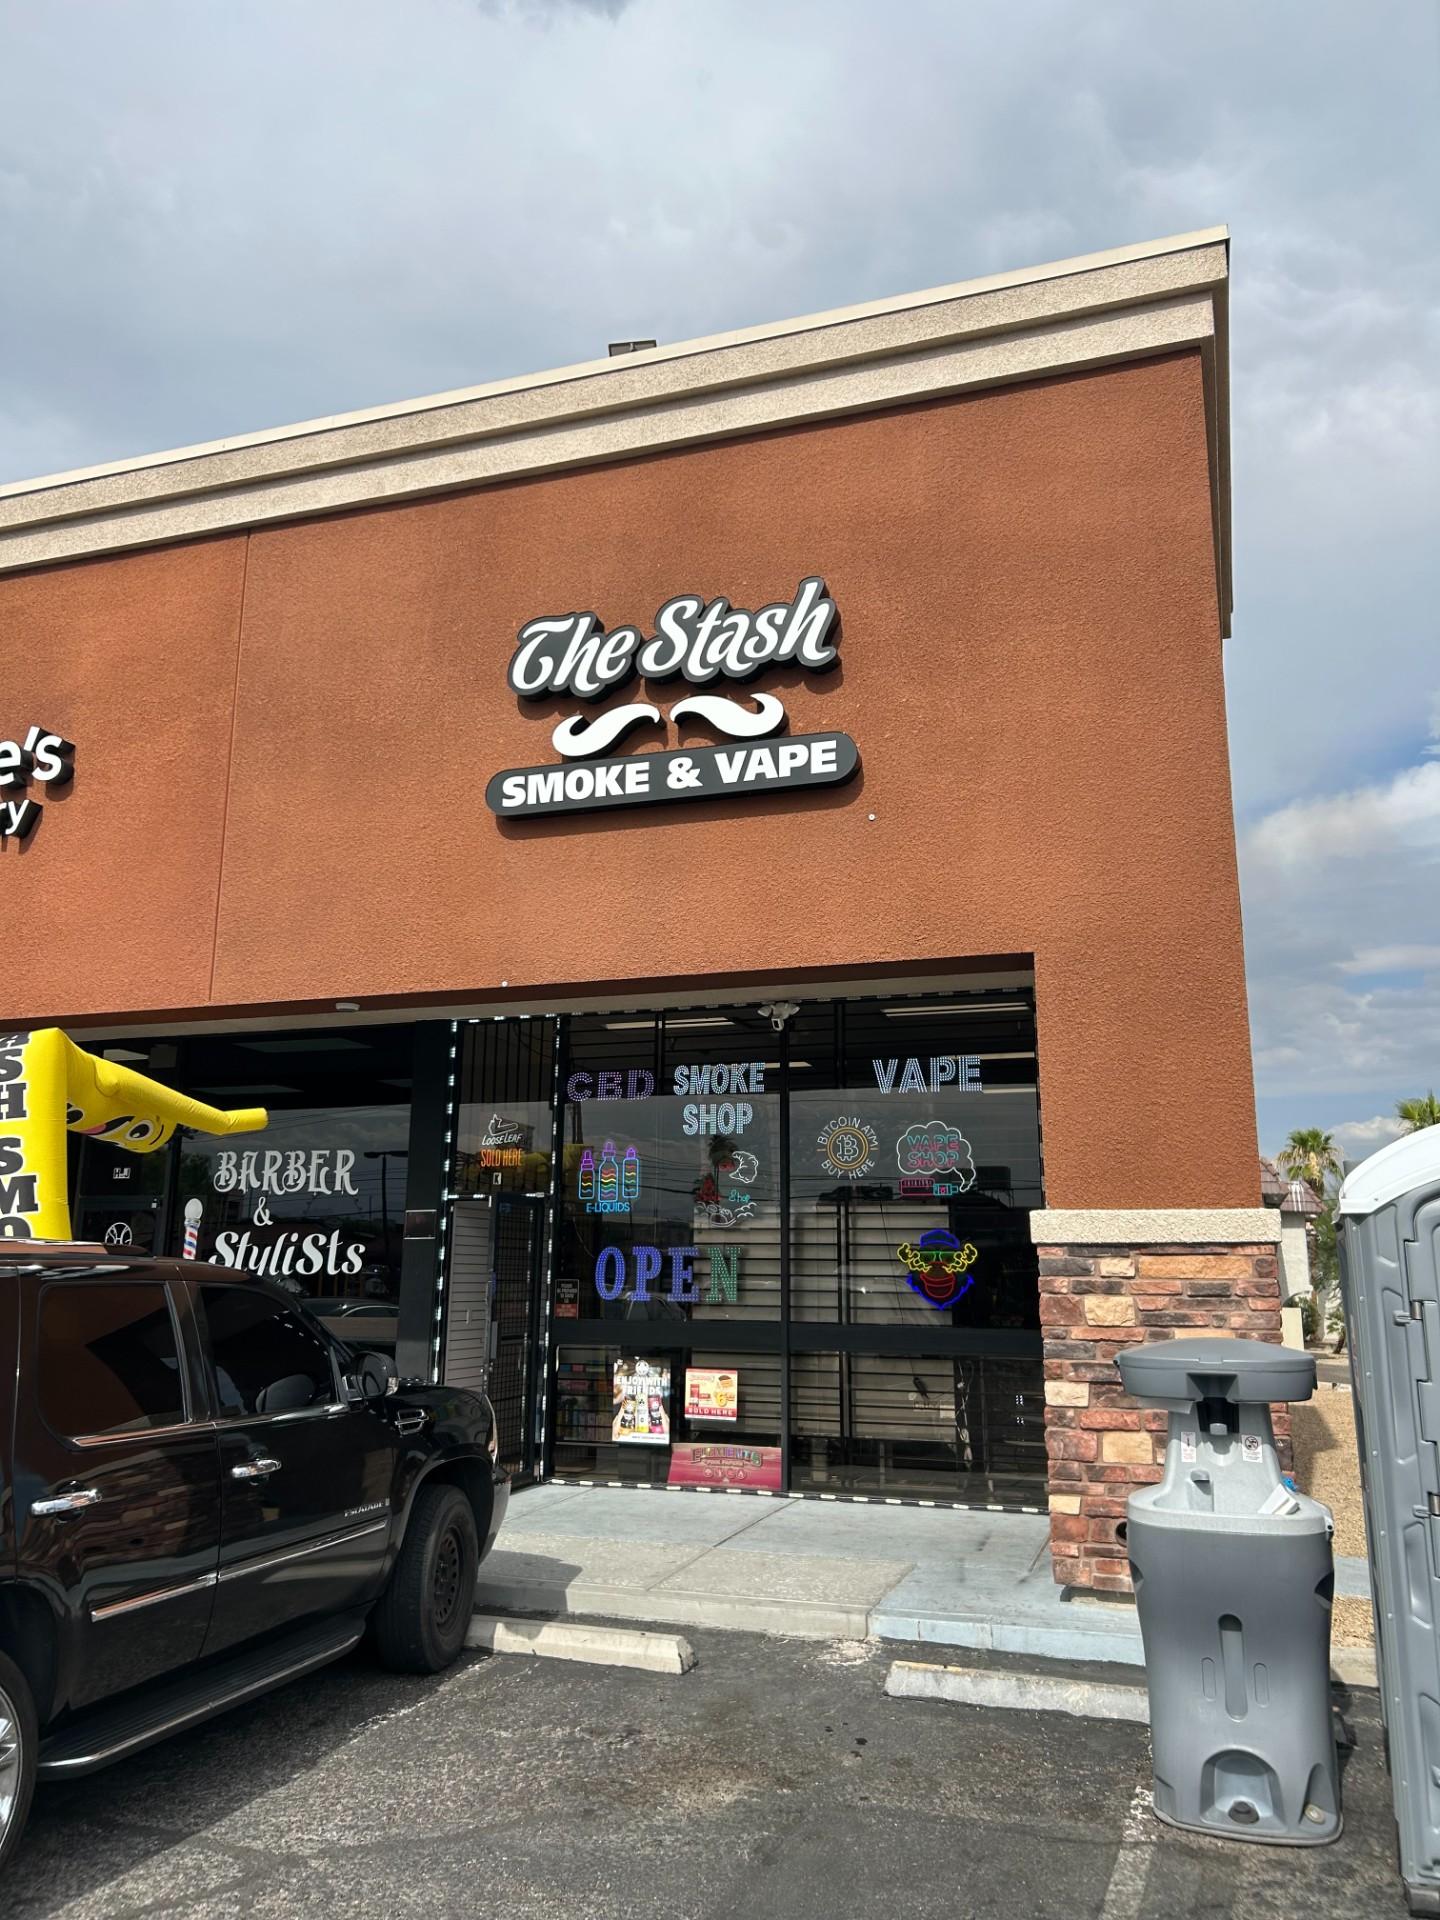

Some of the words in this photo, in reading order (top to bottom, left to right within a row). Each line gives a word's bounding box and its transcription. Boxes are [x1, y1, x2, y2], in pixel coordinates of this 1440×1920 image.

[511, 614, 636, 693] The
[640, 580, 838, 677] Stash
[501, 761, 651, 808] SMOKE
[666, 756, 704, 789] &
[714, 739, 839, 785] VAPE
[566, 1069, 656, 1102] CBD
[672, 1062, 766, 1096] SMOKE
[872, 1055, 984, 1095] VAPE
[682, 1102, 754, 1136] SHOP
[816, 1116, 861, 1145] BITCOIN
[860, 1125, 879, 1147] ATM
[480, 1148, 502, 1168] SOLD
[502, 1147, 524, 1167] HERE
[906, 1133, 960, 1151] VAPE
[213, 1150, 359, 1196] BARBER
[821, 1159, 845, 1179] BUY
[848, 1158, 876, 1180] HERE
[252, 1197, 274, 1227] &
[585, 1201, 631, 1213] E-LIQUIDS
[594, 1245, 742, 1302] OPEN
